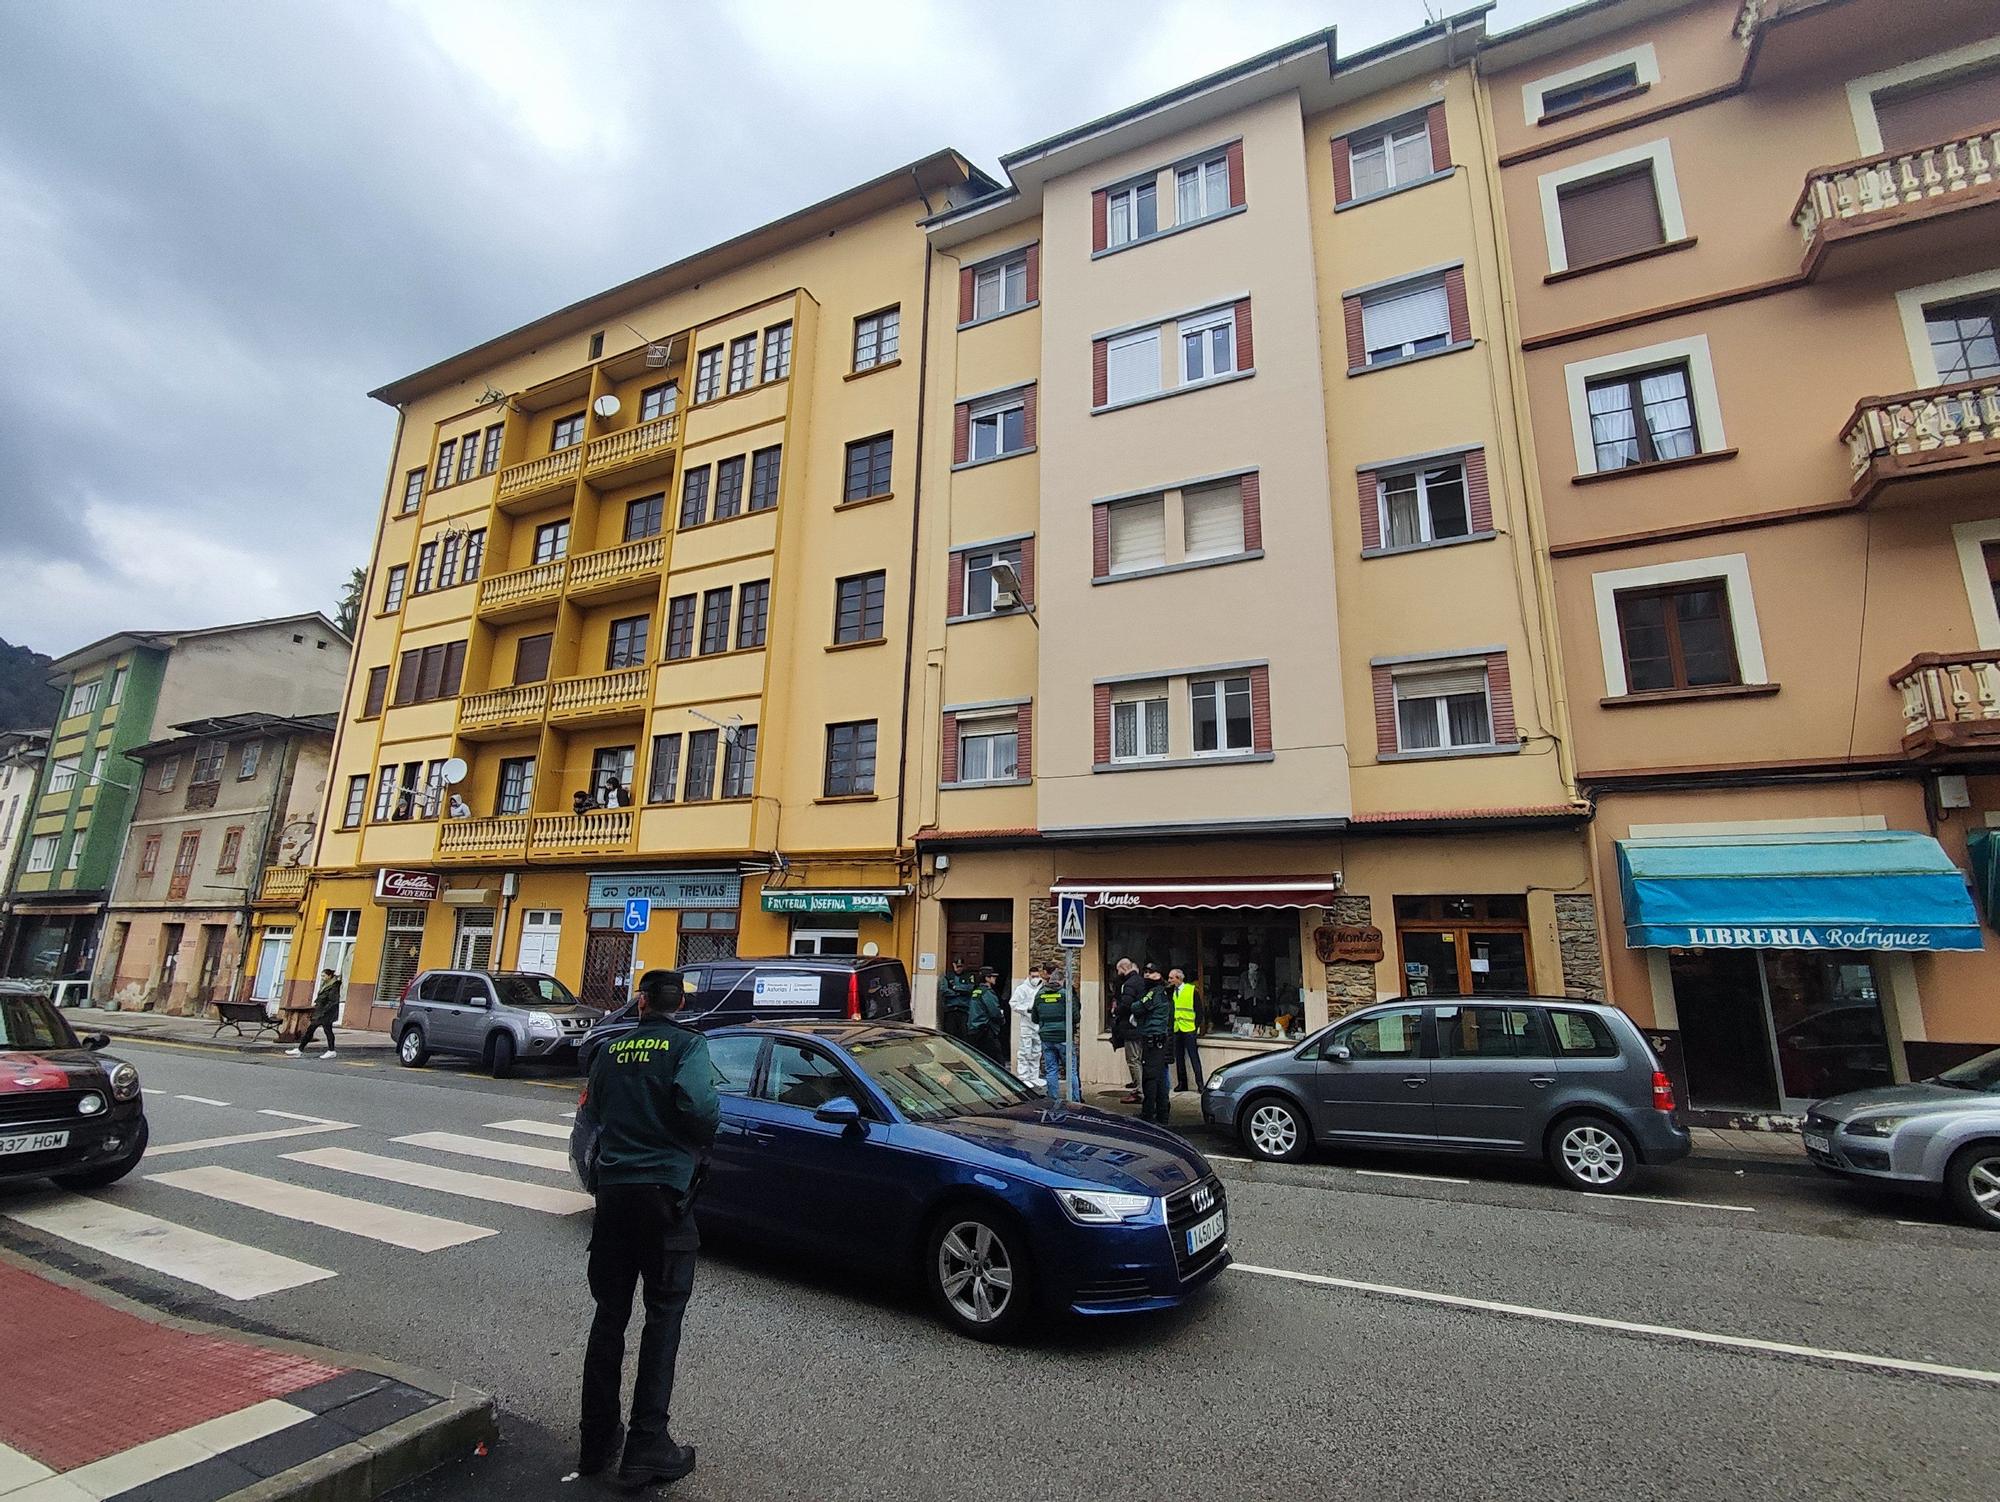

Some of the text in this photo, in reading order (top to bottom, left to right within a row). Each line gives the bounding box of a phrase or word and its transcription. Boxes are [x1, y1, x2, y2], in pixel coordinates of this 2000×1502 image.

[400, 889, 432, 898] JOYERIA
[627, 884, 725, 897] OPTICA TREVIAS
[1095, 892, 1141, 905] Montse
[1688, 927, 1930, 948] LIBRERIA Rodriguez
[608, 1039, 670, 1063] GUARDIA CIVIL
[32, 1134, 64, 1149] HGM
